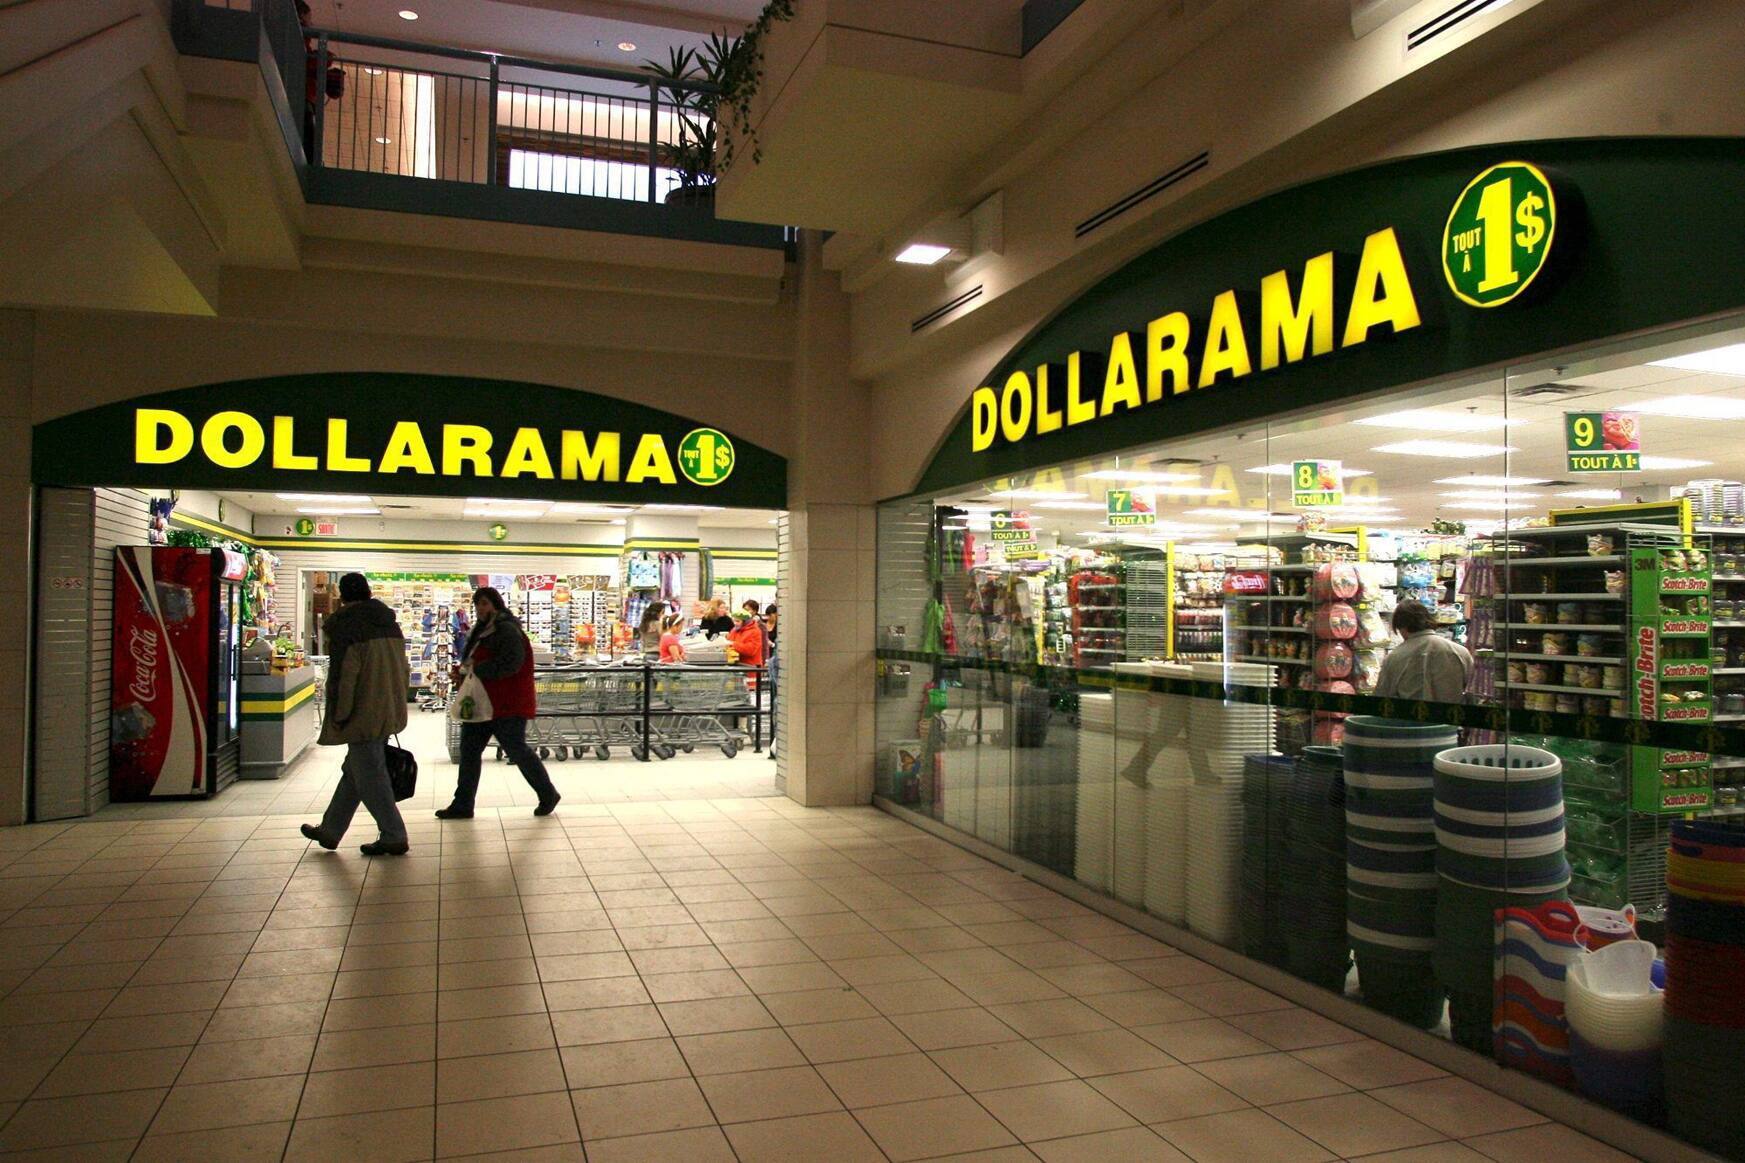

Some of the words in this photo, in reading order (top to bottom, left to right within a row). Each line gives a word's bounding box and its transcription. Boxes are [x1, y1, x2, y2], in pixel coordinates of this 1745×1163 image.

[1452, 227, 1482, 254] TOUT
[972, 226, 1422, 452] DOLLARAMA
[1574, 417, 1594, 447] 9
[135, 408, 678, 485] DOLLARAMA
[1571, 456, 1609, 469] TOUT
[1298, 465, 1313, 488] 8
[1113, 493, 1127, 512] 7
[1296, 494, 1319, 505] TOUT
[1110, 516, 1135, 525] TOUT
[1634, 558, 1656, 571] 3M
[1662, 577, 1708, 591] Scotch-Brite
[1662, 620, 1708, 634] Scotch-Brite
[1635, 627, 1656, 720] cotch-Brite
[1663, 664, 1709, 677] Scotch-Brite
[1663, 707, 1708, 720] Scotch-Brite
